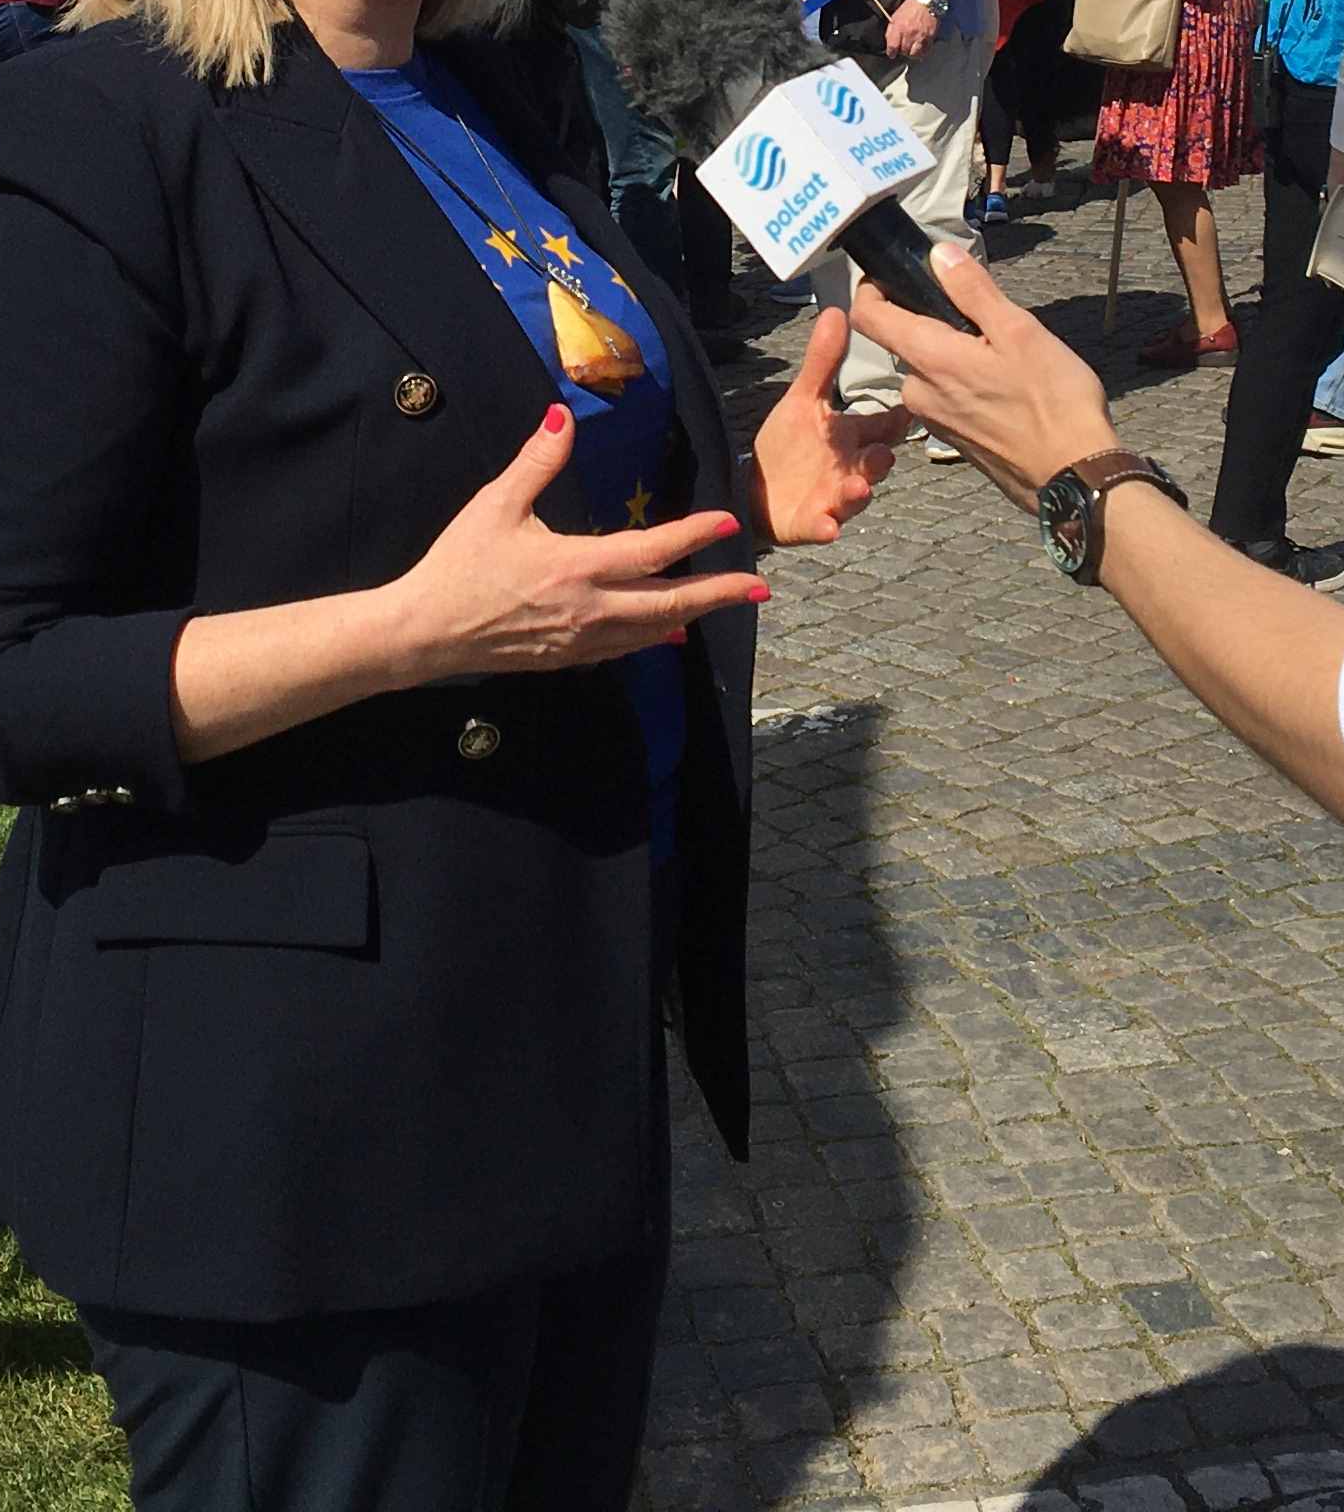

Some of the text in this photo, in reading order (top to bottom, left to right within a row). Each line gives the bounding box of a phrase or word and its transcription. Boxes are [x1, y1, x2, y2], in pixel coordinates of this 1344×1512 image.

[849, 128, 903, 165] polsat
[872, 152, 916, 180] news
[765, 173, 828, 242] polsat
[788, 202, 839, 255] news
